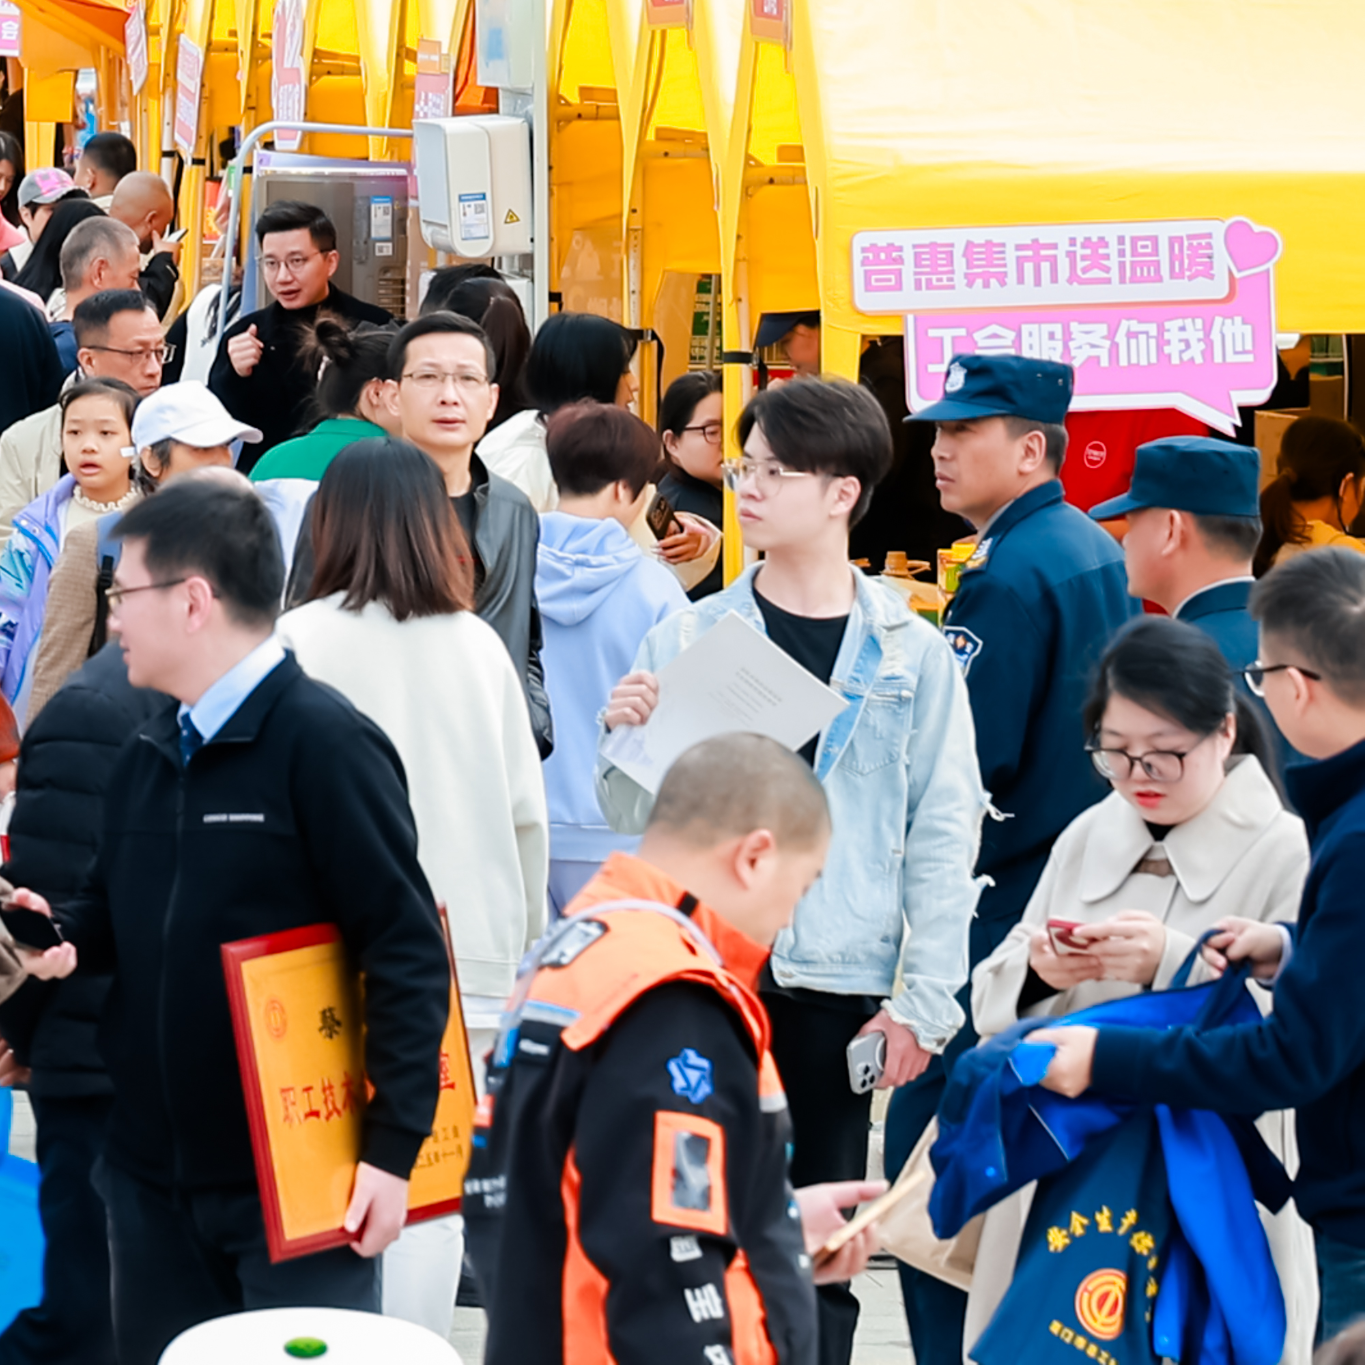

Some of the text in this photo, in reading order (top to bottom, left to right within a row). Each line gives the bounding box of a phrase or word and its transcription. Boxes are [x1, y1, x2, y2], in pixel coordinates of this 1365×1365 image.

[859, 231, 1217, 295] 普惠集市送温暖
[926, 315, 1256, 373] 工会服务你我他
[279, 1067, 376, 1129] 职工技术
